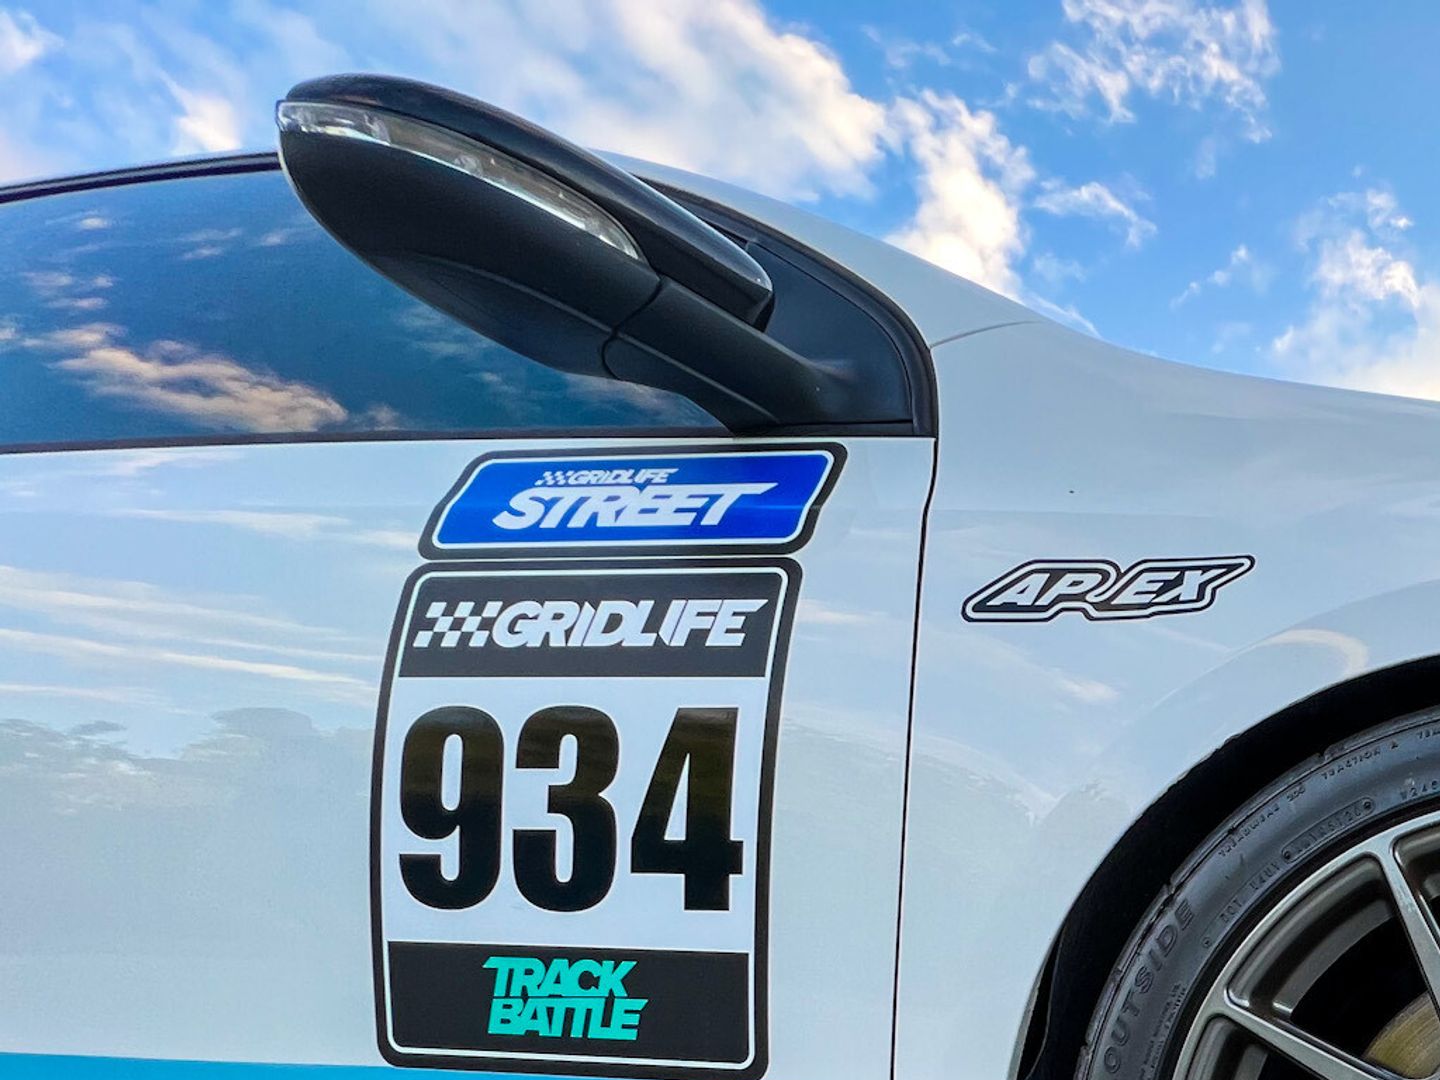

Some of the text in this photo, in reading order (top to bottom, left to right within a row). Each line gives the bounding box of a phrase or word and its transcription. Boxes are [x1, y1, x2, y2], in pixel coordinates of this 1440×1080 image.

[567, 468, 679, 485] GRIDLIFE
[491, 482, 779, 530] STREET
[970, 560, 1245, 614] APEX
[492, 599, 769, 647] GRIDLIFE
[399, 705, 745, 912] 934
[482, 956, 637, 998] TRACK
[1103, 899, 1195, 1075] OUTSIDE
[487, 999, 649, 1040] BATTLE
